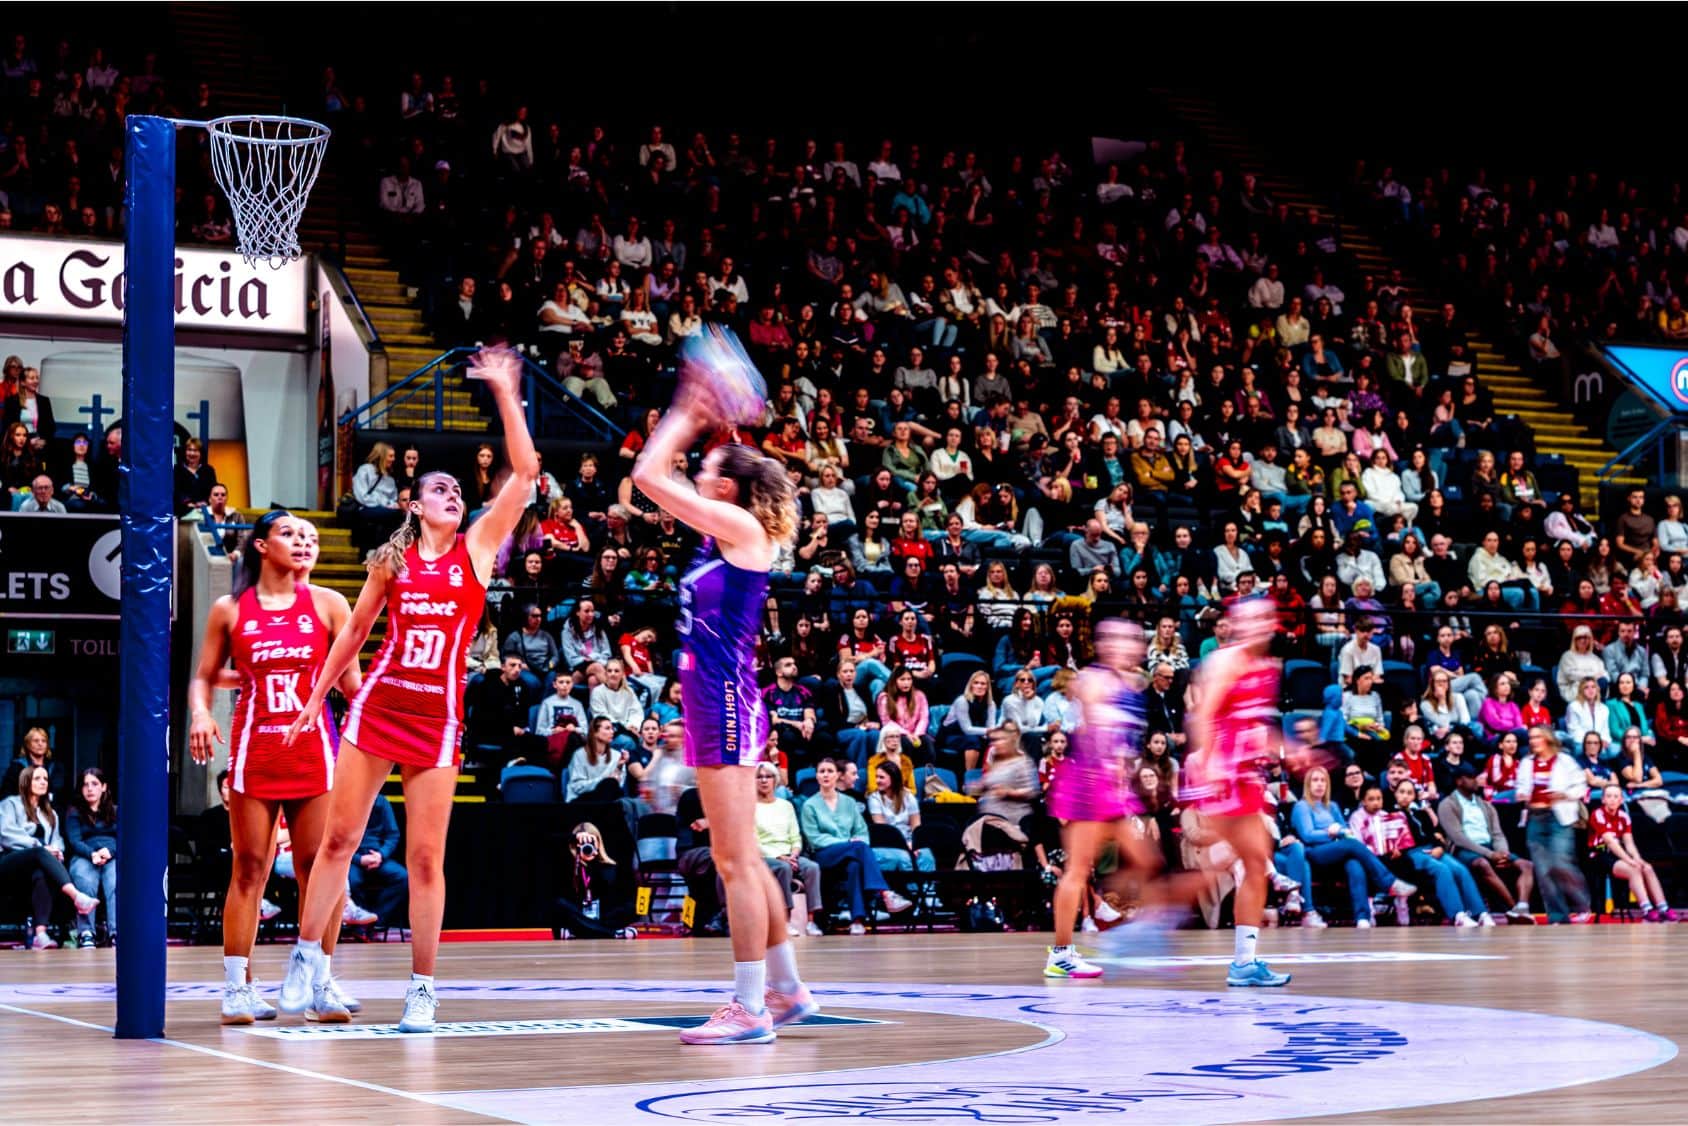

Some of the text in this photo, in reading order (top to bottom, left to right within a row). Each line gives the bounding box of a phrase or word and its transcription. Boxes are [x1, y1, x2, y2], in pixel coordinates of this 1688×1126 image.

[3, 250, 271, 320] a Gicia
[400, 601, 458, 616] next
[70, 639, 120, 656] TOIL
[252, 645, 313, 663] next
[400, 628, 446, 670] GD
[266, 672, 304, 713] GK
[724, 680, 737, 752] LIGHTNING
[1144, 1049, 1396, 1080] SHOT
